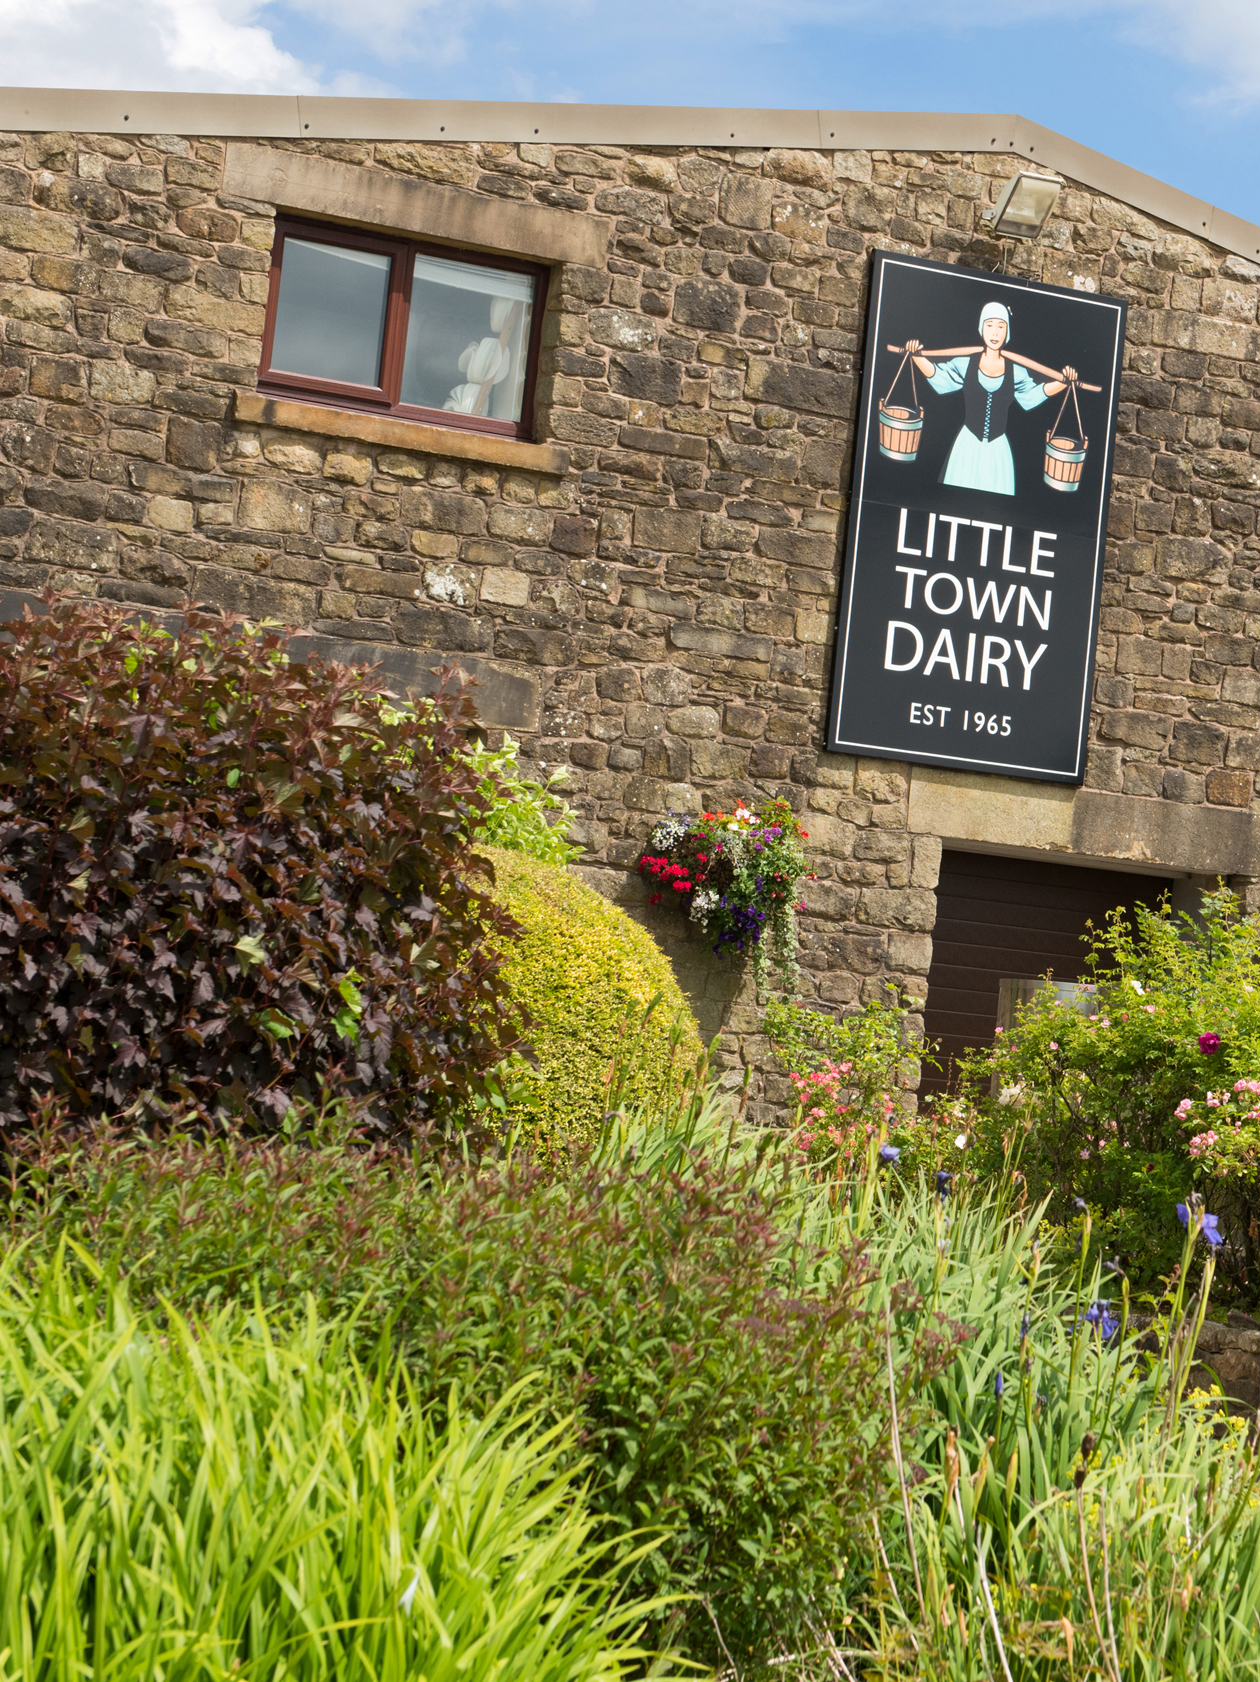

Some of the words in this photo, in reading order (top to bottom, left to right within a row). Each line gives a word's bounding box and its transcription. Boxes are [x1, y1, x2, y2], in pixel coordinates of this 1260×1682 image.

[896, 507, 1058, 579] LITTLE
[894, 565, 1052, 631] TOWN
[883, 620, 1048, 691] DAIRY
[909, 702, 951, 729] EST
[963, 708, 1012, 737] 1965
